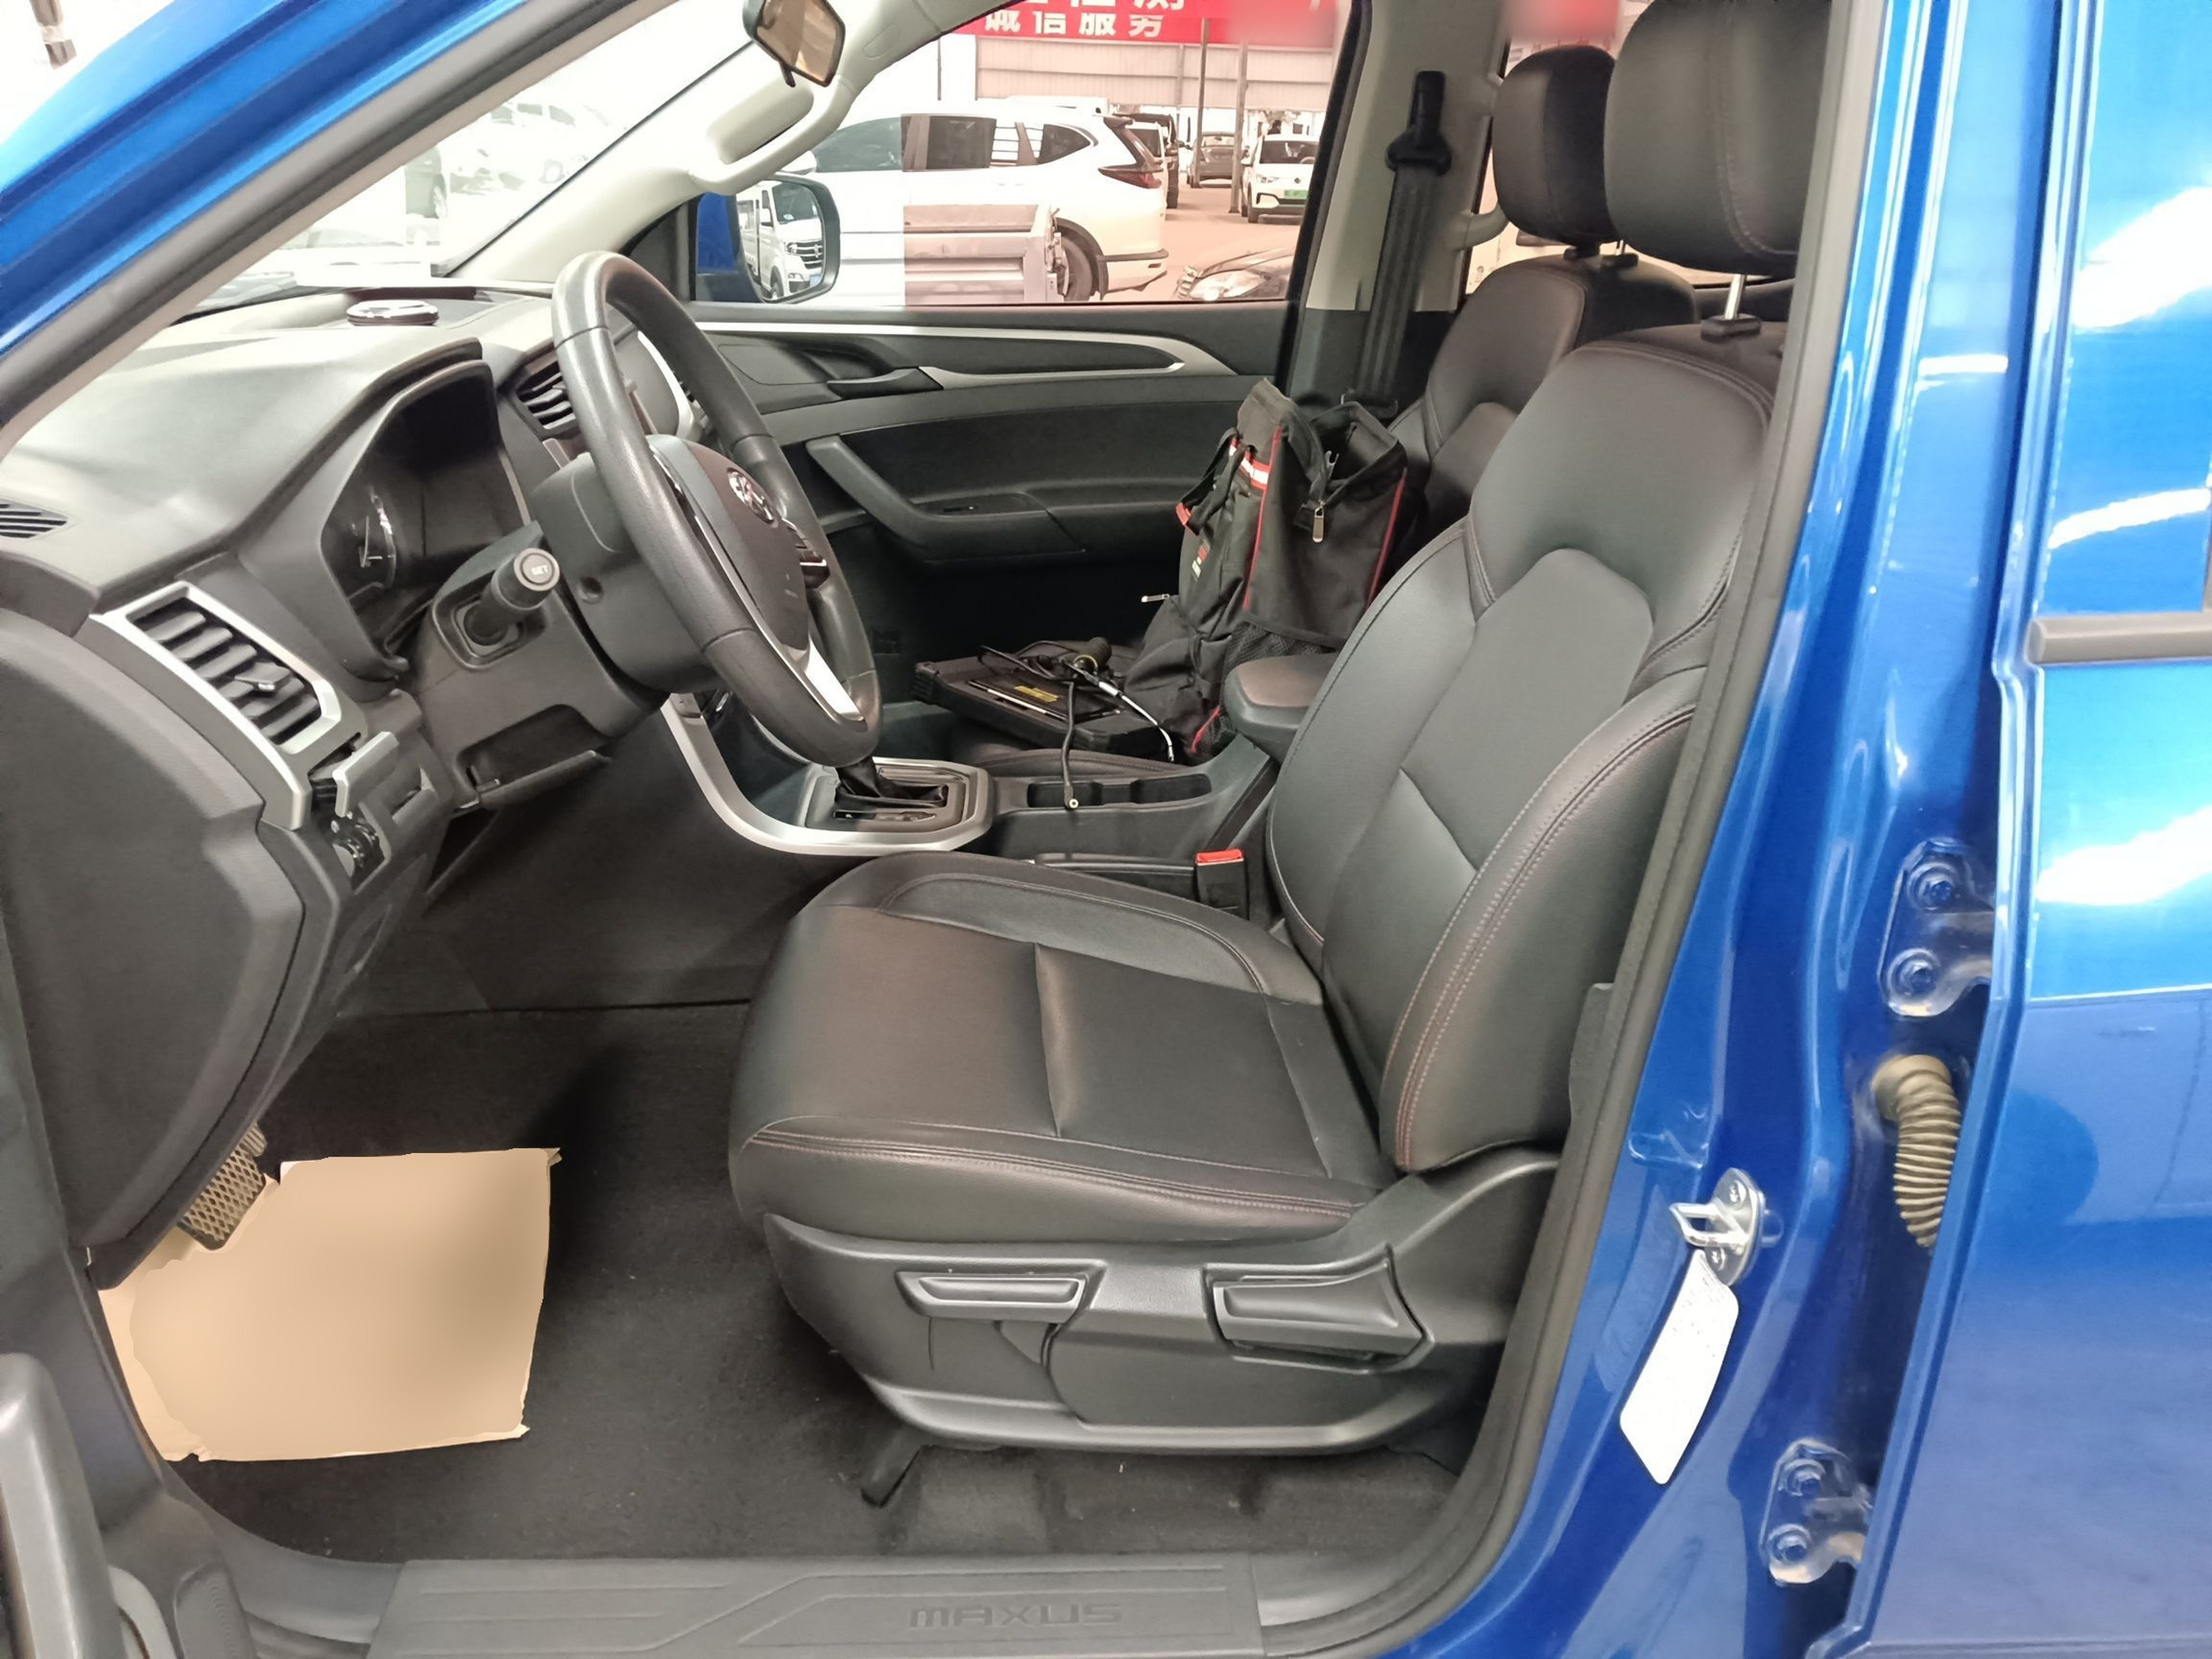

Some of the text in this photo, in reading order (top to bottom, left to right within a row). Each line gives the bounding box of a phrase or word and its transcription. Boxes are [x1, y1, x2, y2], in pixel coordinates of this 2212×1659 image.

[984, 9, 1164, 37] 诚信服务
[909, 1604, 1122, 1627] MAXUS
